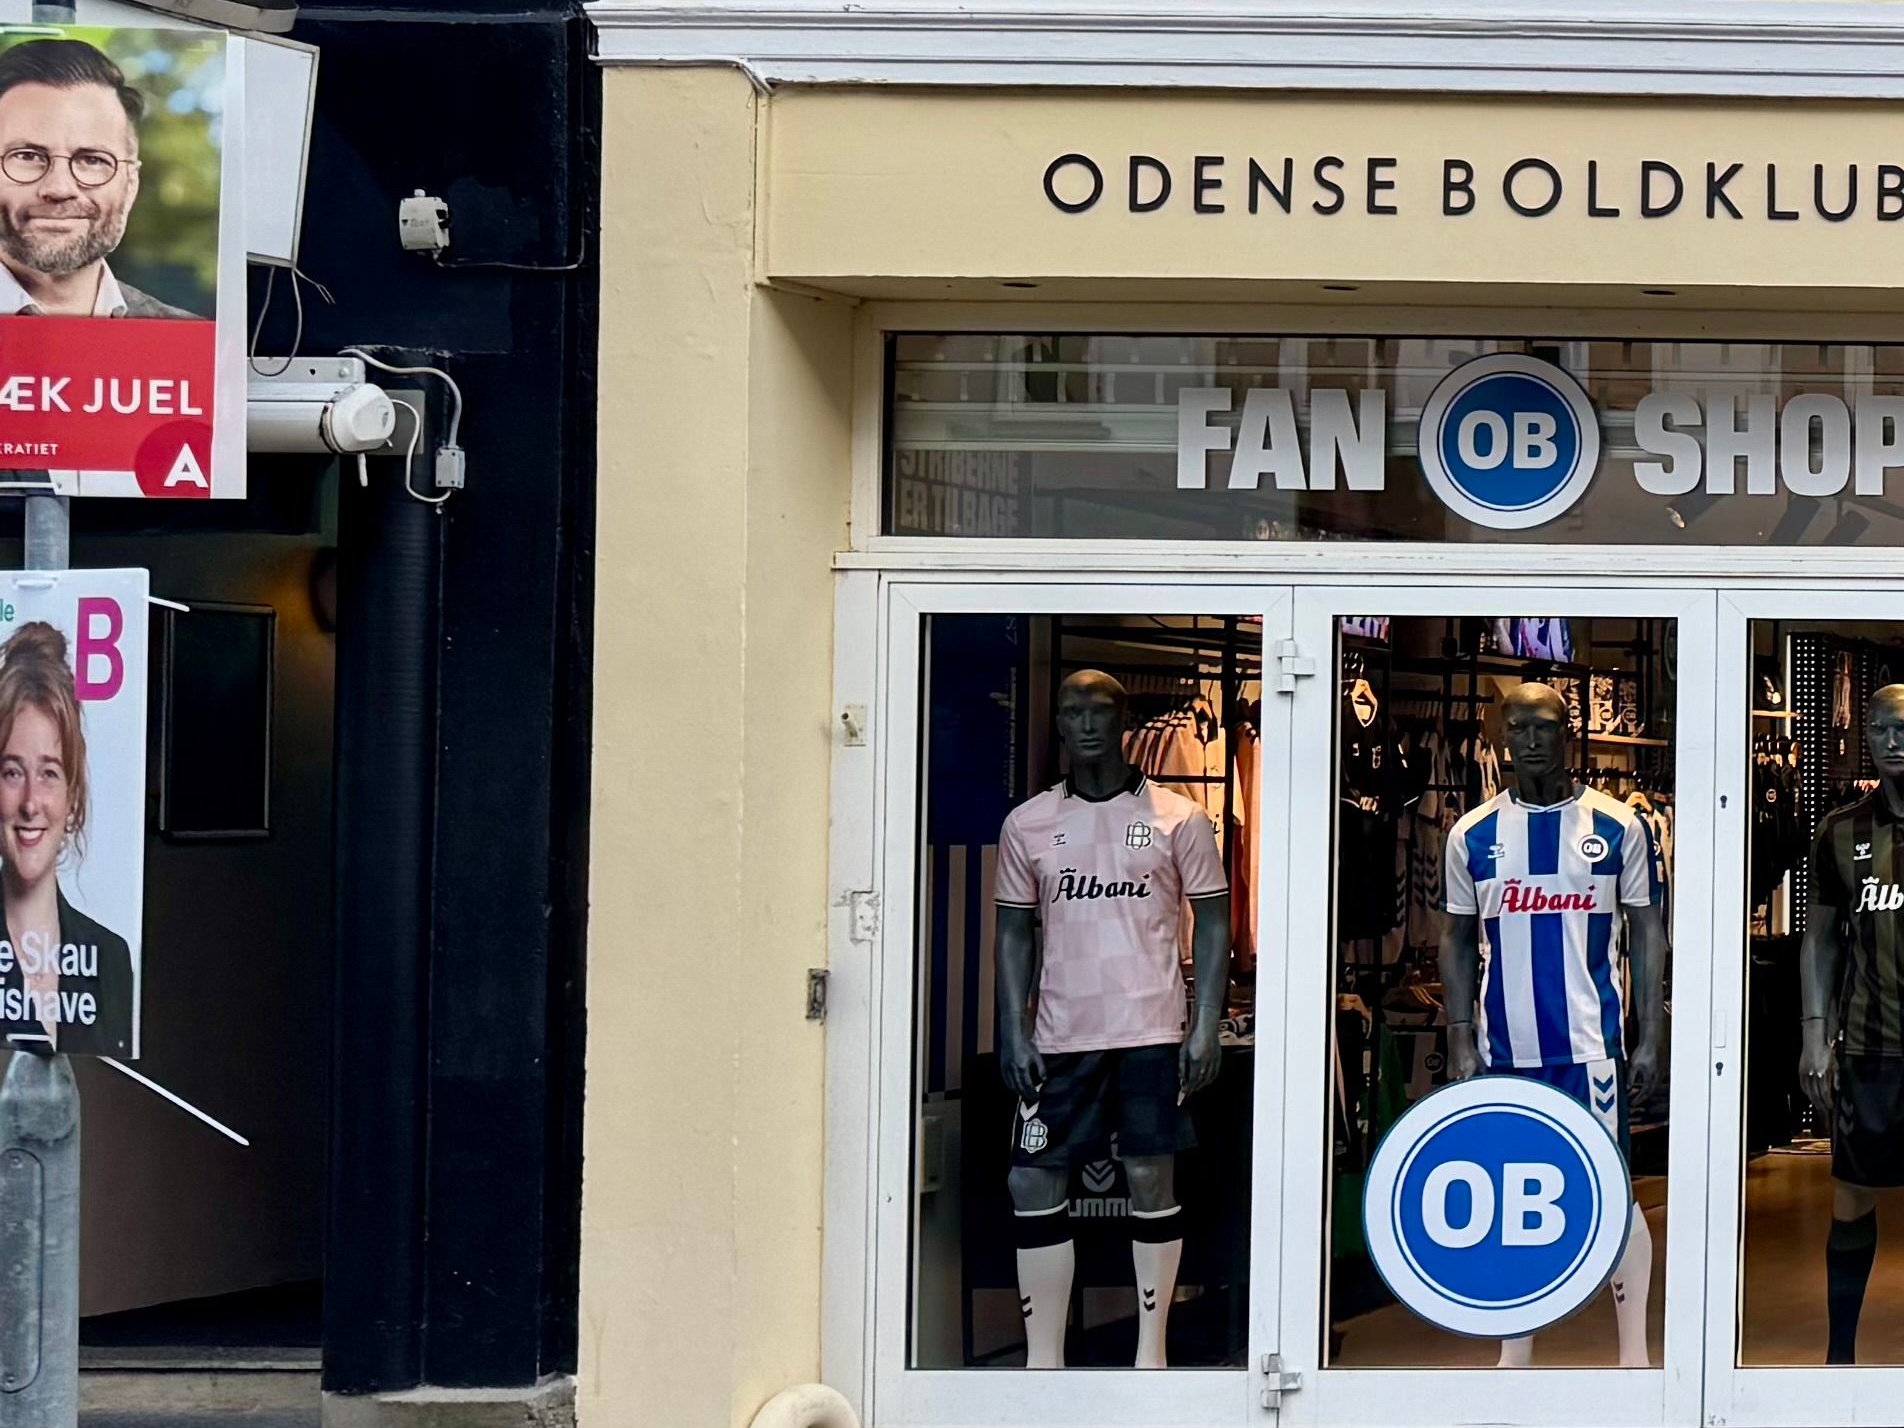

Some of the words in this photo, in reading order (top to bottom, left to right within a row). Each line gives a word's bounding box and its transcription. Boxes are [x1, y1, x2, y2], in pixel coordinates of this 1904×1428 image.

[1042, 152, 1398, 217] ODENSE
[82, 378, 203, 415] JUEL
[163, 442, 209, 488] A
[1177, 387, 1386, 492] FAN
[1456, 410, 1557, 470] OB
[75, 597, 124, 701] B
[1052, 868, 1151, 903] Albani
[1498, 878, 1597, 913] Albani
[21, 931, 98, 977] Skau
[1422, 1160, 1566, 1248] OB
